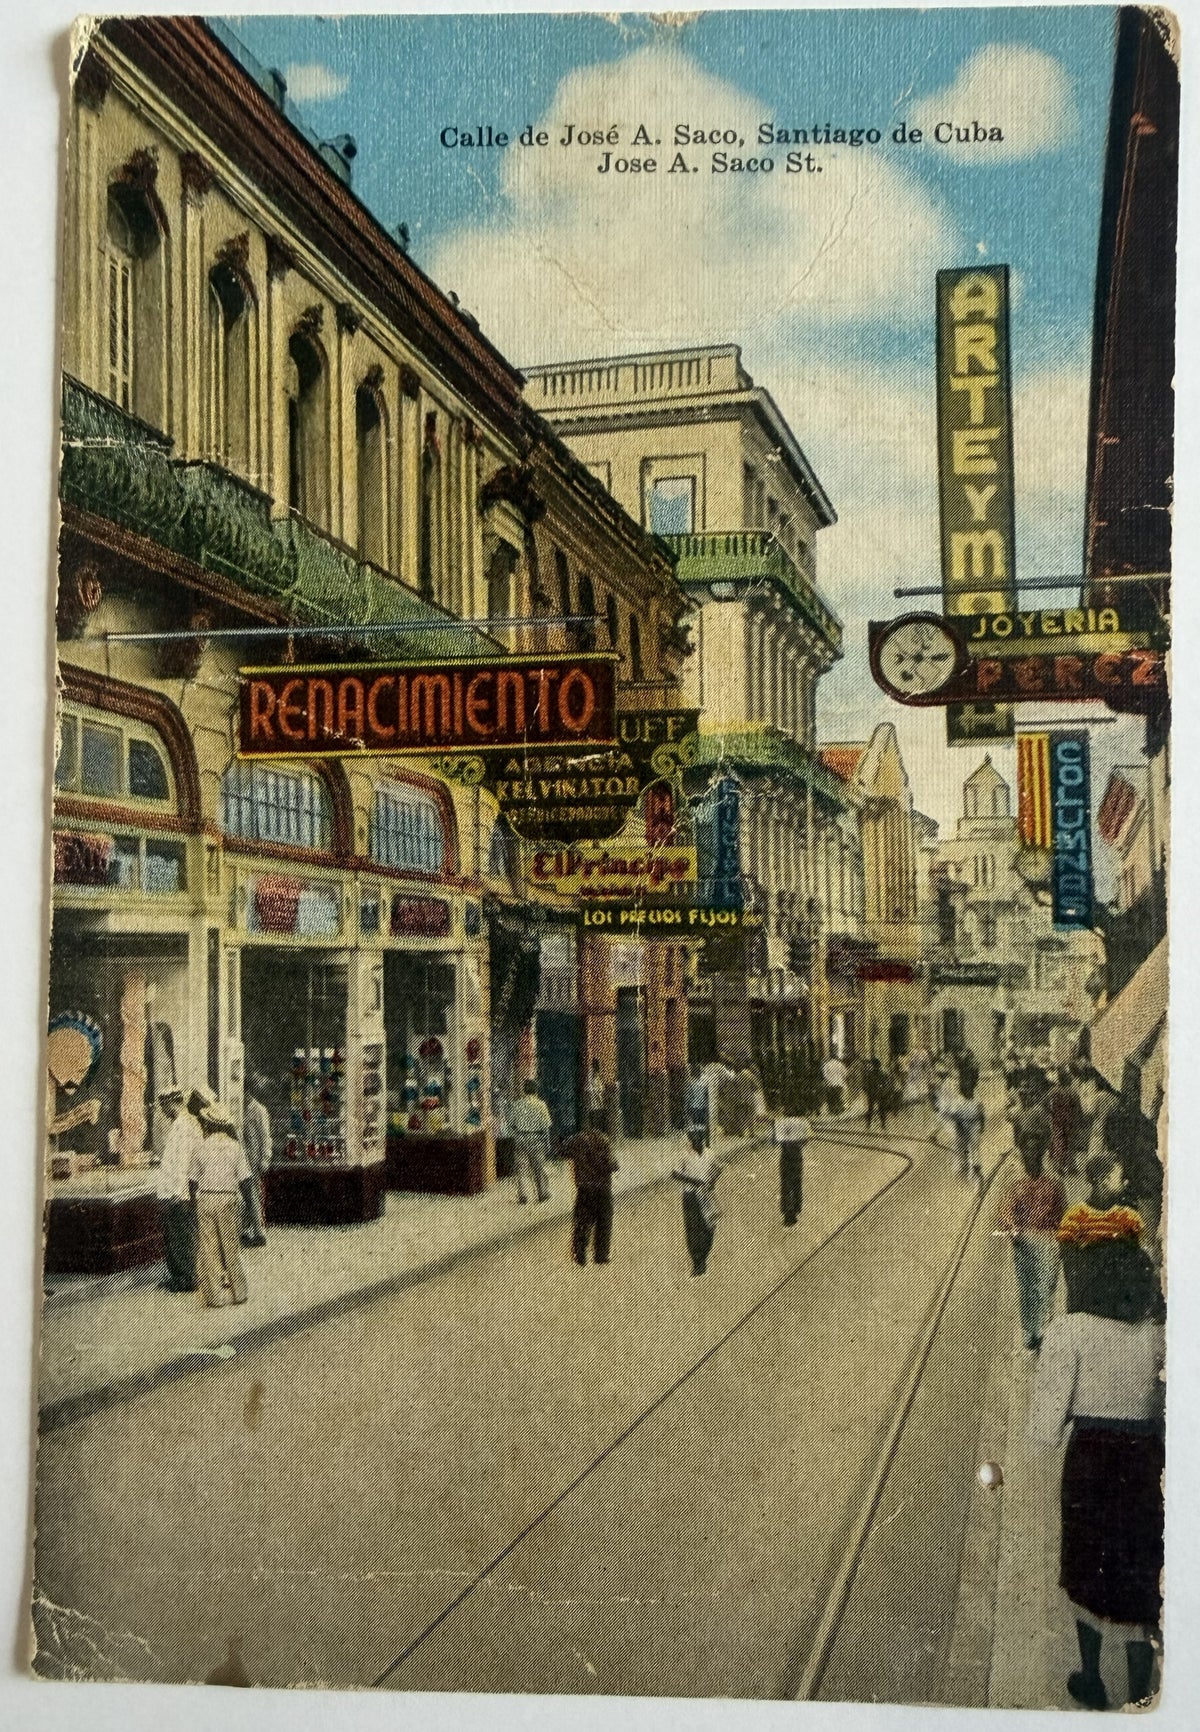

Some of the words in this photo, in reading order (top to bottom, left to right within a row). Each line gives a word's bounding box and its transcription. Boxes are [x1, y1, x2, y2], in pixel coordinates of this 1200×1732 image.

[971, 607, 1121, 639] JOYERIA
[976, 650, 1162, 694] PEREZ
[249, 668, 596, 740] RENACIMIENTO
[495, 775, 641, 801] KELVINATOR
[583, 909, 614, 926] LOS
[619, 908, 682, 926] PRECIOS
